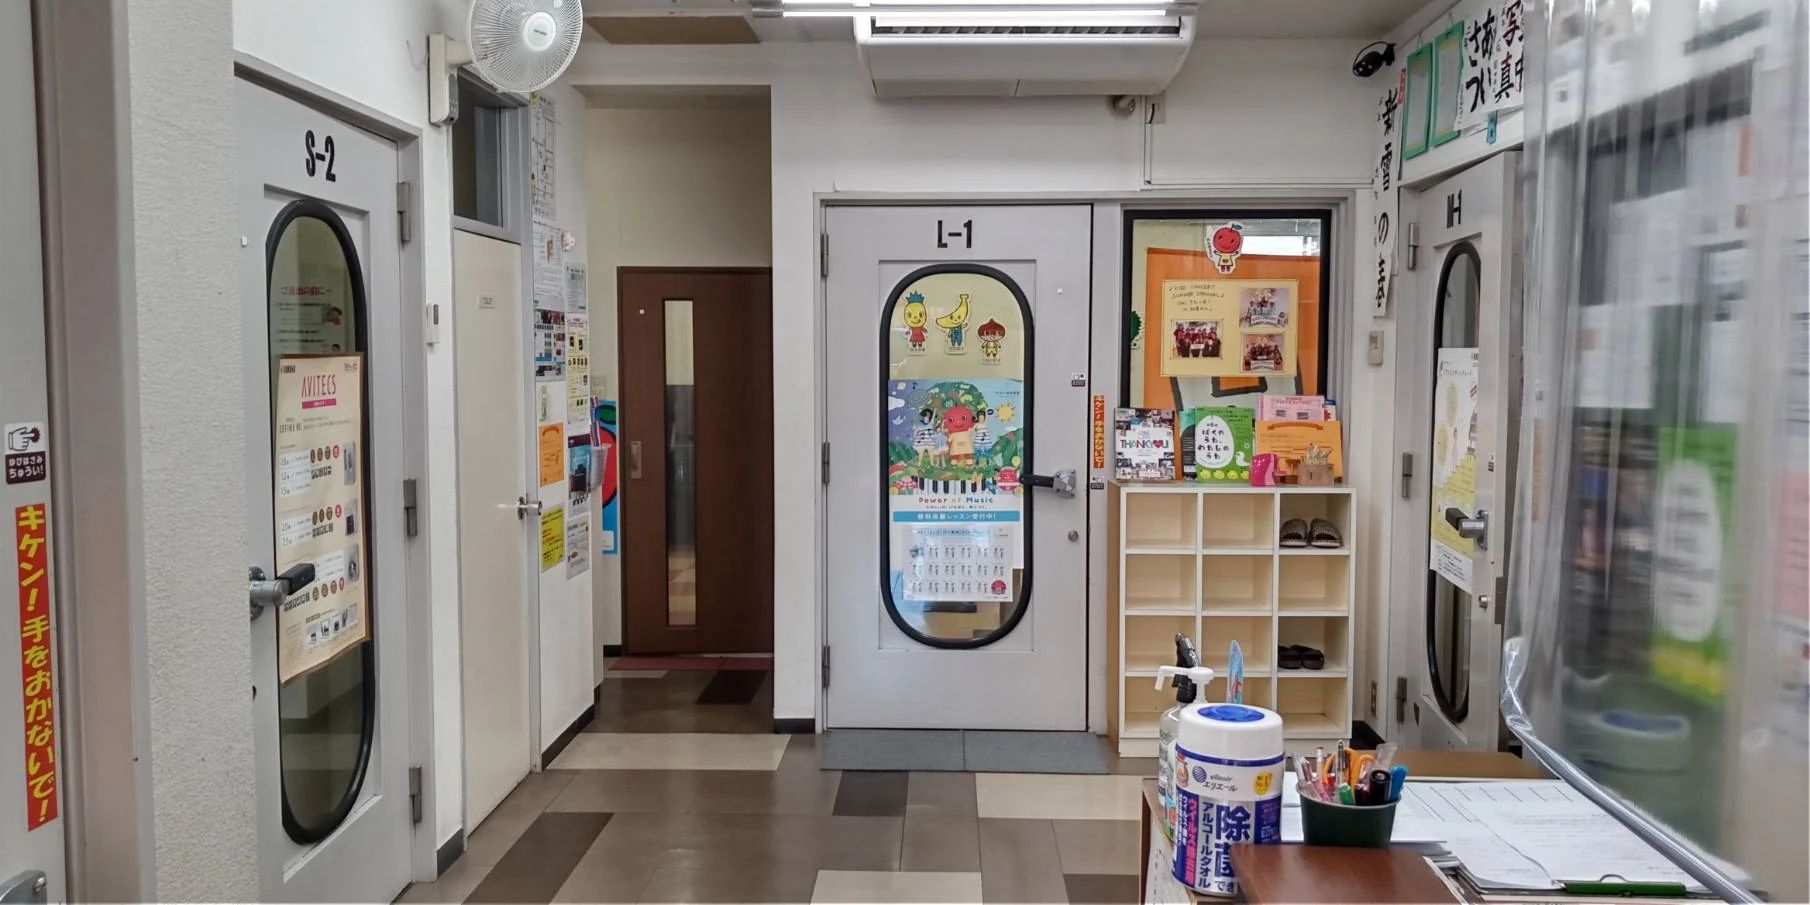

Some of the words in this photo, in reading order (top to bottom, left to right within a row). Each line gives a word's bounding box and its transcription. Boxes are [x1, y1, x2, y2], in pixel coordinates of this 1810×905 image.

[305, 130, 336, 182] S-2
[937, 219, 972, 249] L-1
[301, 374, 337, 398] AVITECS
[9, 456, 43, 466] ゆびはさみ
[9, 464, 44, 479] ちゅうい!
[17, 505, 54, 823] キケン!手をおかないで!
[1202, 781, 1238, 792] エリエール
[1198, 802, 1214, 889] アルコールタオル
